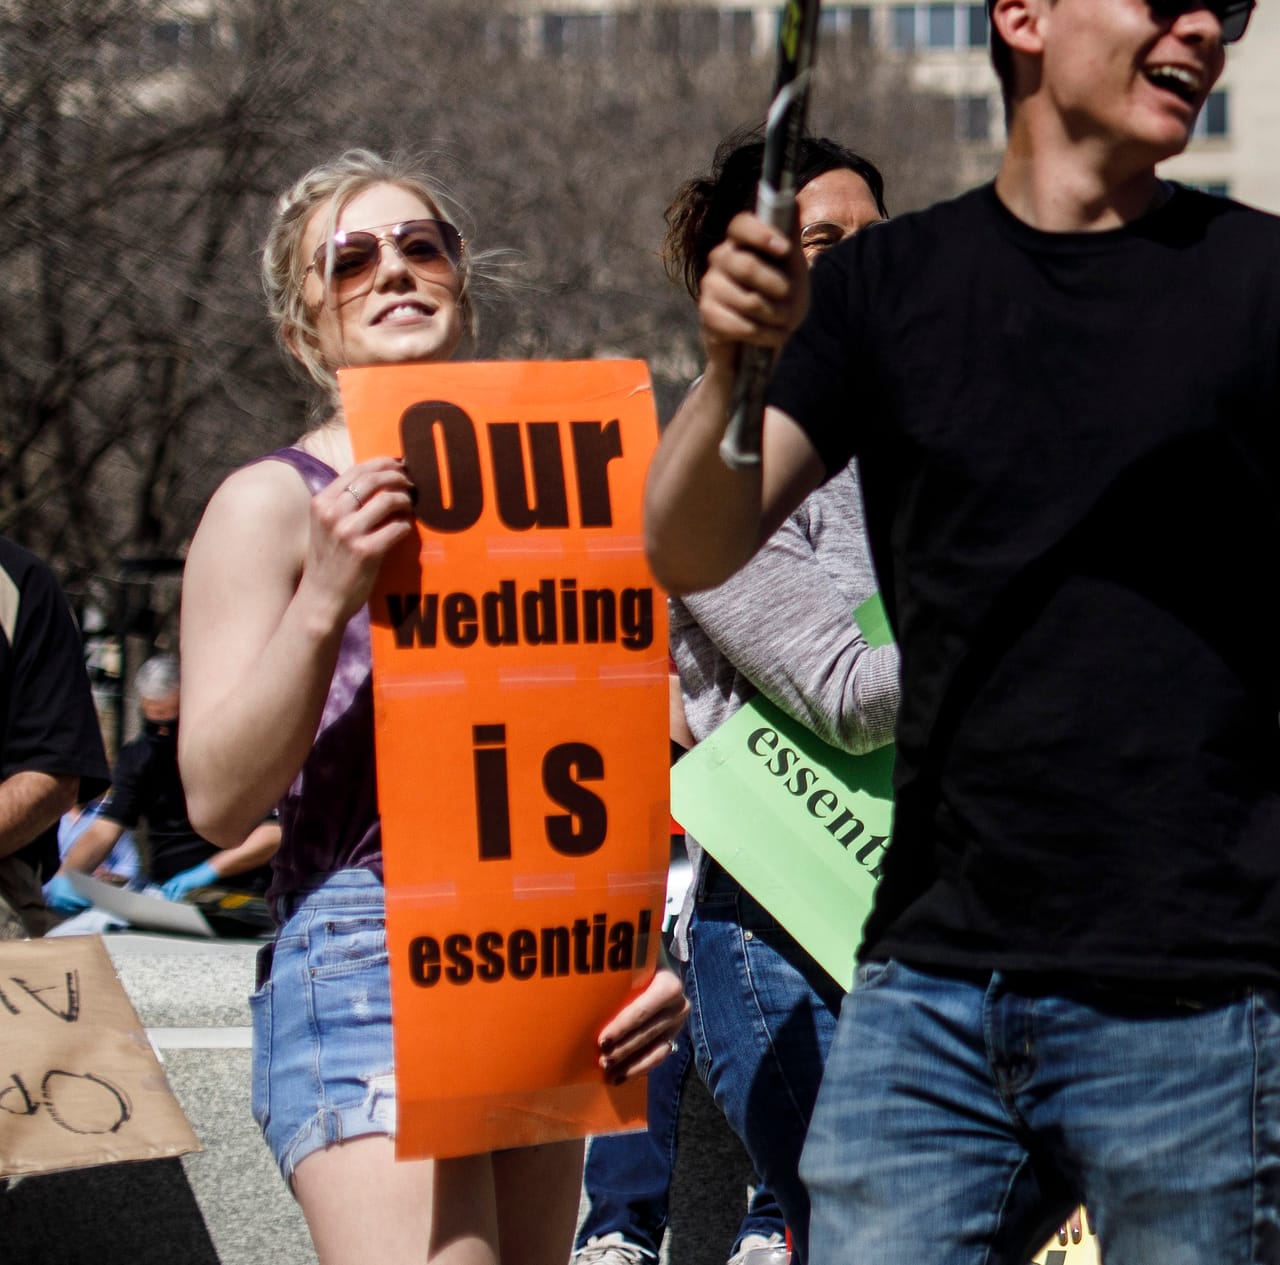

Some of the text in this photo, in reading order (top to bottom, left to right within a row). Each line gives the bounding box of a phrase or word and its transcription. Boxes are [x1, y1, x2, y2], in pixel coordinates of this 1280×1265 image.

[398, 399, 623, 534] Our
[386, 578, 654, 653] wedding
[472, 723, 609, 863] is
[408, 910, 652, 988] essential
